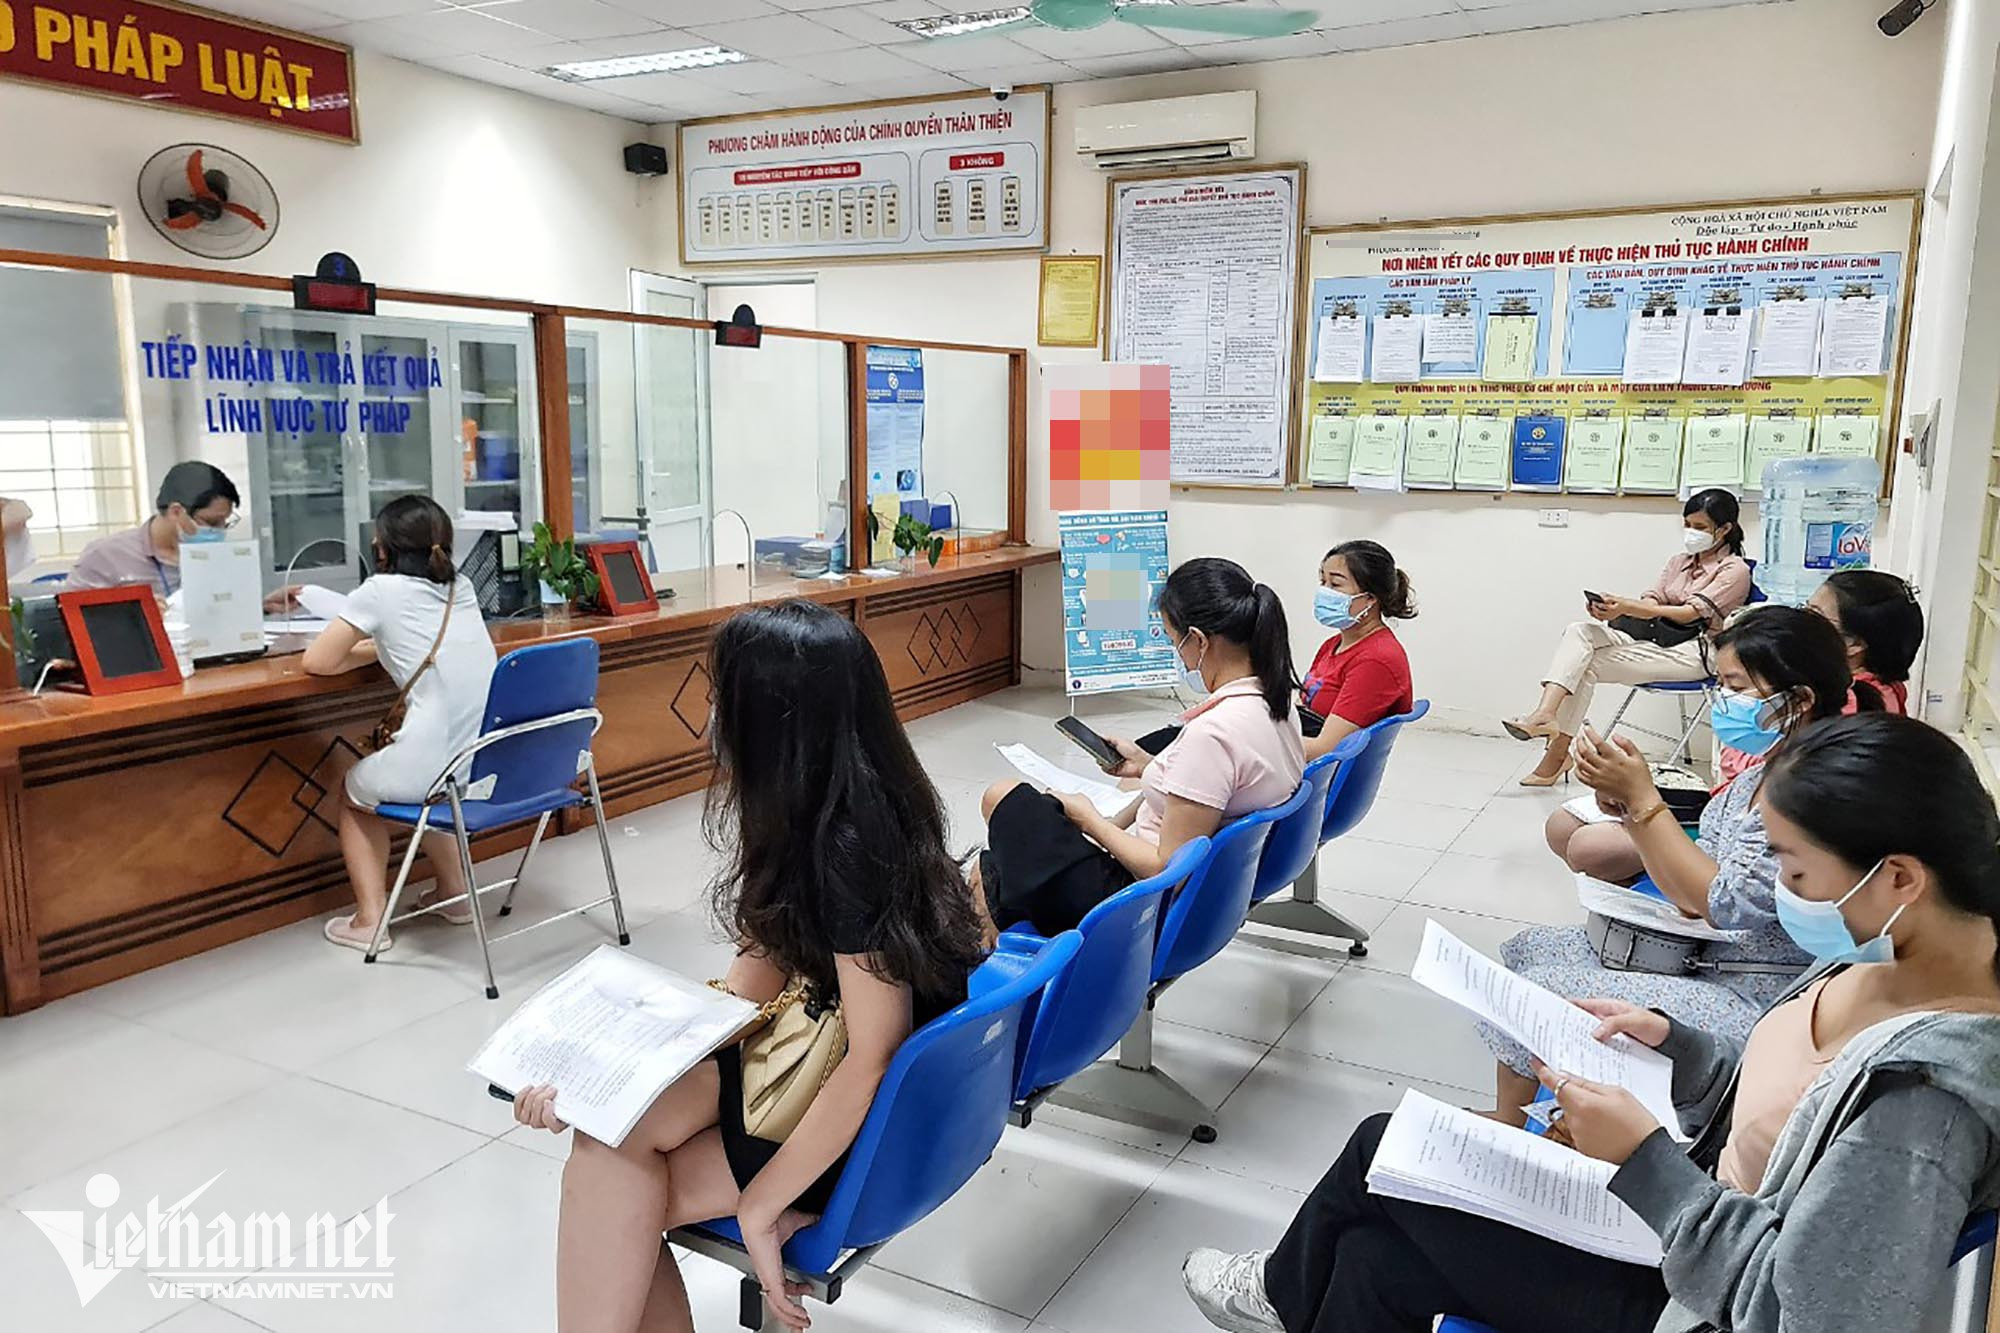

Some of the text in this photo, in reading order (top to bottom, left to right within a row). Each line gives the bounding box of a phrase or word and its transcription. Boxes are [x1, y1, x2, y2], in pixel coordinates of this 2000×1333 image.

[34, 7, 184, 83] PHÁP
[197, 43, 313, 117] LUẬT
[781, 128, 809, 148] HÀNH
[812, 124, 841, 149] ĐỘNG
[844, 119, 866, 142] CỦA
[869, 118, 901, 140] CHÍNH
[978, 108, 1012, 134] THIỆN
[1671, 215, 1700, 226] CỘNG
[1728, 211, 1743, 222] XÃ
[1745, 211, 1765, 221] HỘI
[1768, 209, 1790, 220] CHỦ
[1794, 208, 1831, 218] NGHĨA
[1833, 206, 1861, 217] VIỆT
[1861, 206, 1888, 215] NAM
[1792, 220, 1825, 232] Hạnh
[1382, 258, 1403, 271] NƠI
[1406, 254, 1438, 270] NIÊM
[1441, 250, 1462, 268] YẾT
[1466, 251, 1491, 268] CÁC
[1495, 252, 1519, 267] QUY
[1523, 250, 1554, 268] ĐỊNH
[1558, 245, 1575, 263] VỀ
[1579, 246, 1613, 264] THỰC
[1617, 243, 1650, 262] HIỆN
[1651, 238, 1681, 258] THỦ
[1686, 241, 1712, 260] TỤC
[1717, 238, 1757, 255] HÀNH
[1762, 236, 1809, 252] CHÍNH
[1648, 268, 1665, 278] QUY
[1690, 263, 1714, 275] KHÁC
[1731, 261, 1755, 273] THỰC
[1756, 260, 1778, 272] HIỆN
[1781, 258, 1799, 270] THỦ
[1802, 260, 1819, 270] TỤC
[1821, 257, 1848, 269] HÀNH
[1851, 256, 1880, 268] CHÍNH
[141, 334, 443, 390] TIẾP NHẬN VÀ TRẢ KẾT QUẢ
[206, 393, 411, 440] LĨNH VỰC TƯ PHÁP
